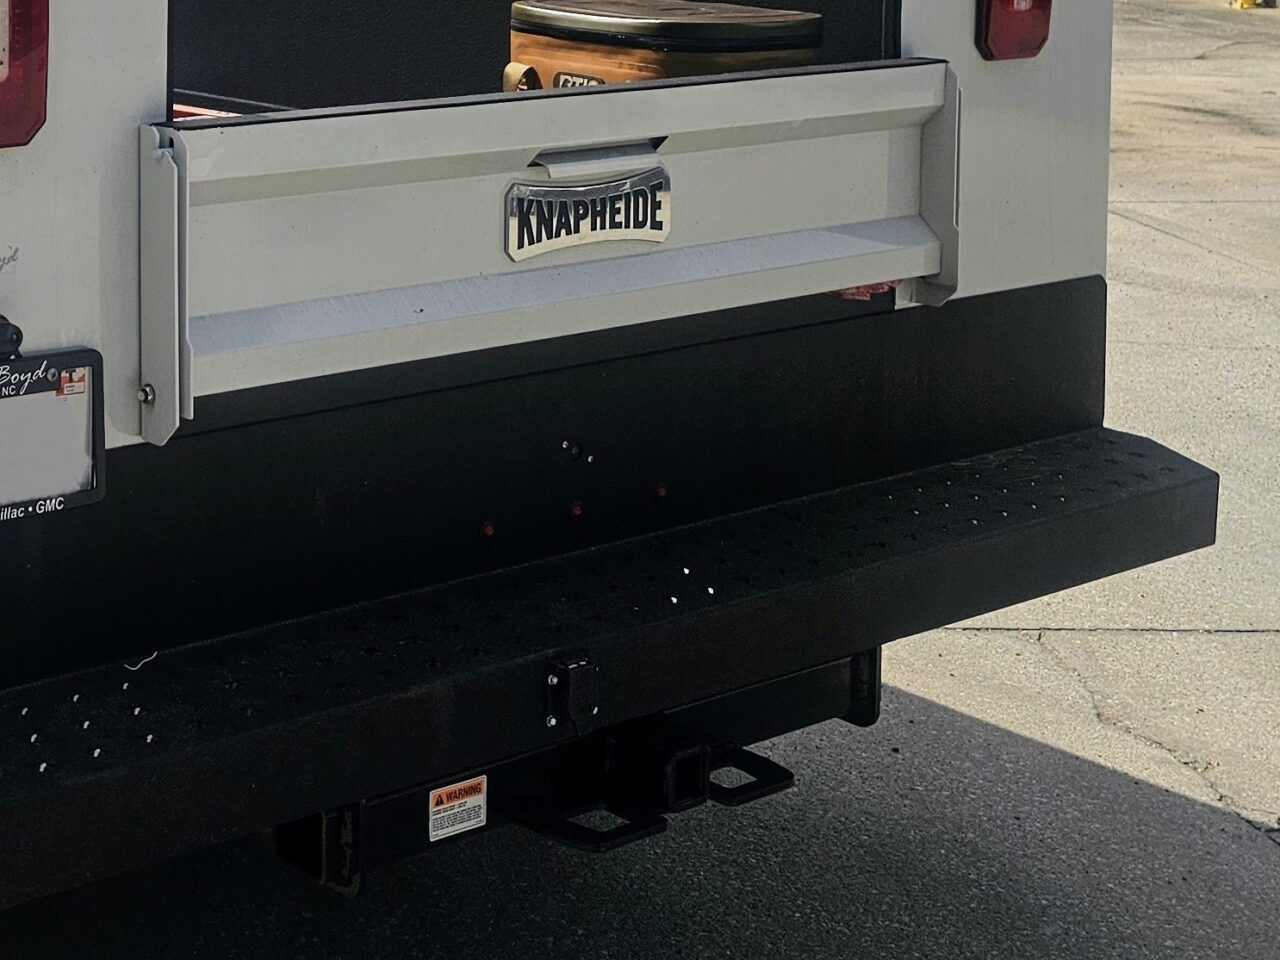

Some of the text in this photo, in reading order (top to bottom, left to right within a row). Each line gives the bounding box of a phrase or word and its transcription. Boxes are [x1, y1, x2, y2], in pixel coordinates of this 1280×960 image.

[517, 180, 664, 250] KNAPHEIDE
[2, 385, 16, 395] NC
[35, 496, 64, 514] GMC
[446, 783, 482, 802] WARNING
